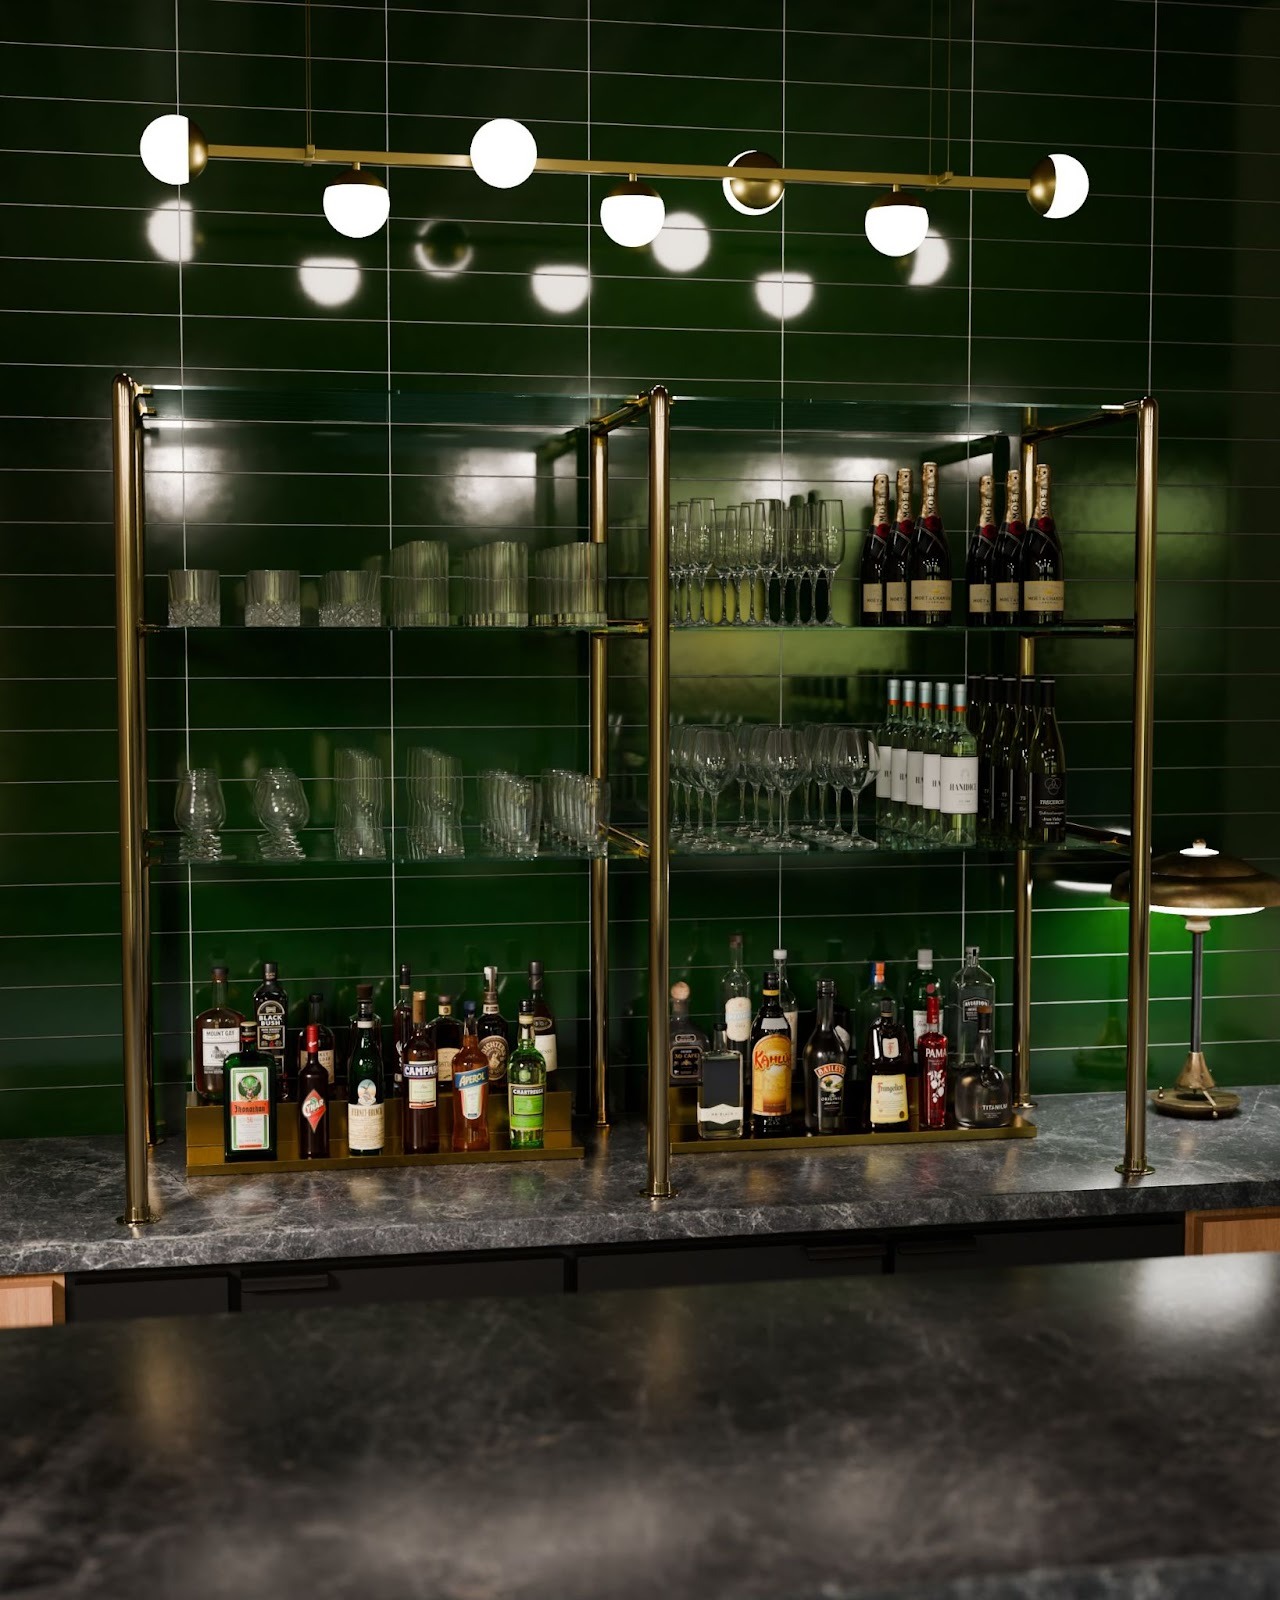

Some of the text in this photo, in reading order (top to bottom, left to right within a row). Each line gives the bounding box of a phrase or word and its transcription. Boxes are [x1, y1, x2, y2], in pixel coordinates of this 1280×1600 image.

[925, 1047, 947, 1058] PAMA
[817, 1064, 845, 1075] BAILEYS
[459, 1072, 486, 1087] APEROL
